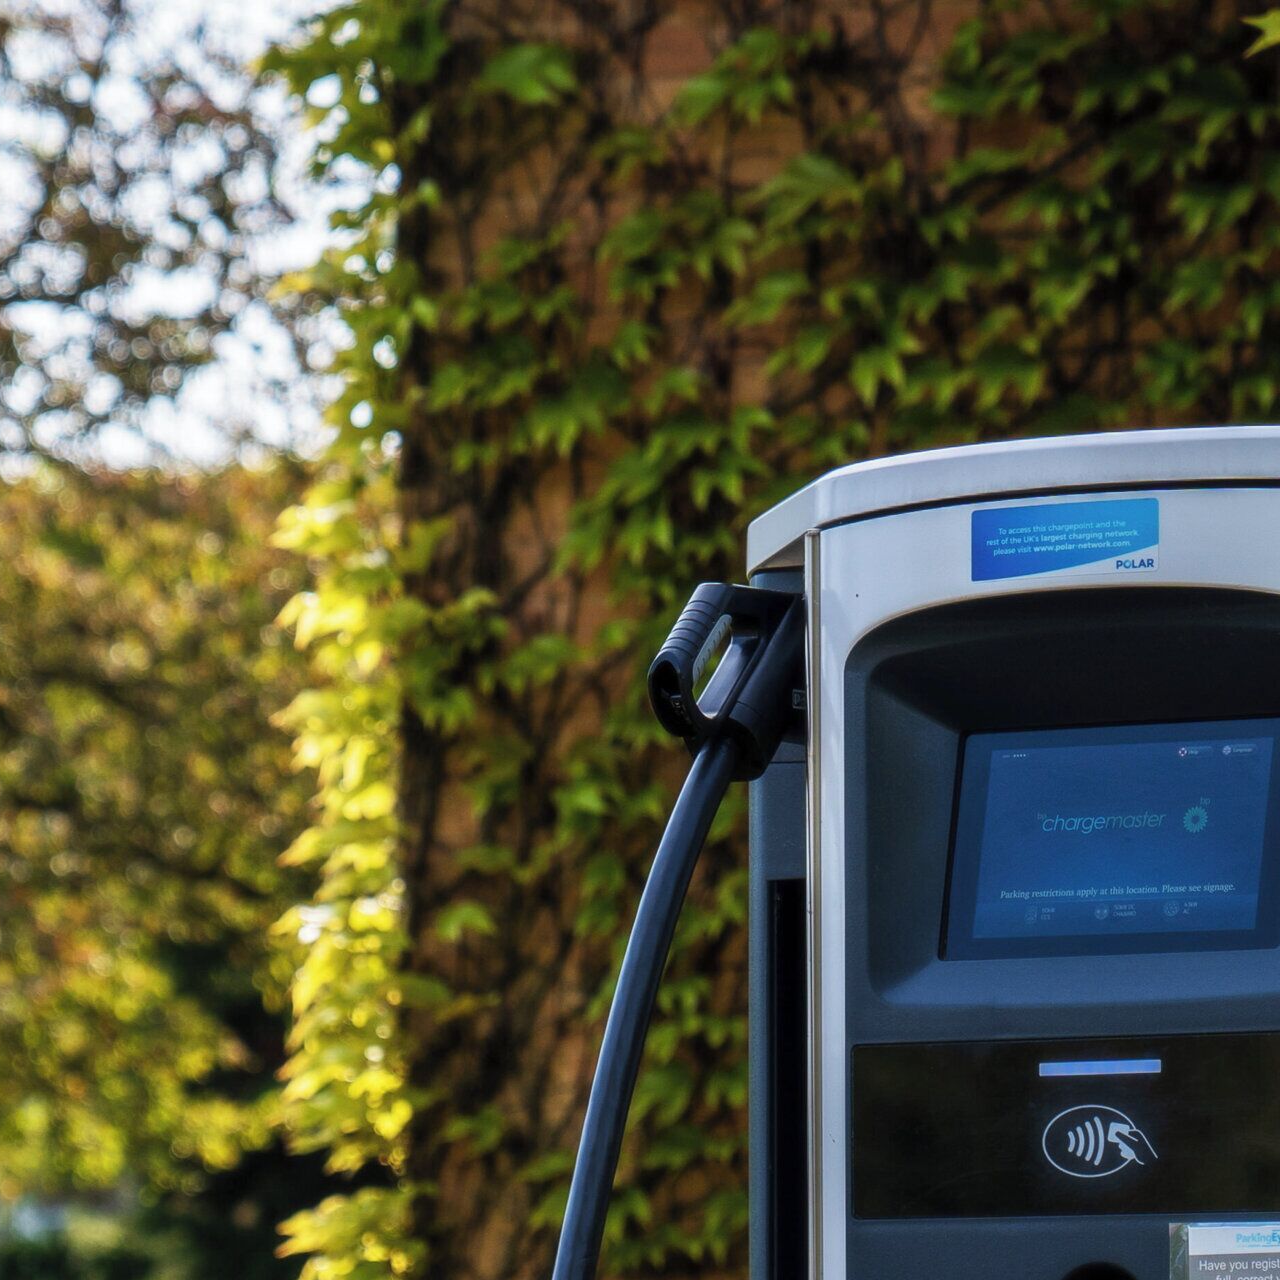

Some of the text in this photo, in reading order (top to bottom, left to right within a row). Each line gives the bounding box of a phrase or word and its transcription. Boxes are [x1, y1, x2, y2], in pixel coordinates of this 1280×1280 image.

[1033, 525, 1046, 533] this
[1048, 522, 1094, 533] chargepoint
[1095, 520, 1110, 528] and
[1001, 537, 1009, 545] of
[1010, 536, 1022, 544] the
[1024, 535, 1039, 543] UK's
[1041, 533, 1067, 543] largest
[1069, 531, 1103, 541] charging
[993, 546, 1016, 556] please
[1018, 545, 1032, 553] visit
[1116, 559, 1154, 570] POLAR
[1042, 811, 1166, 834] chargemaster
[1000, 889, 1030, 900] Parking
[1031, 887, 1074, 898] restrictions
[1076, 887, 1098, 898] apply
[1100, 887, 1108, 895] at
[1110, 886, 1124, 895] this
[1126, 885, 1160, 894] location.
[1162, 884, 1187, 893] Please
[1203, 883, 1236, 893] signage.
[1199, 1260, 1226, 1271] Have
[1230, 1262, 1248, 1272] you
